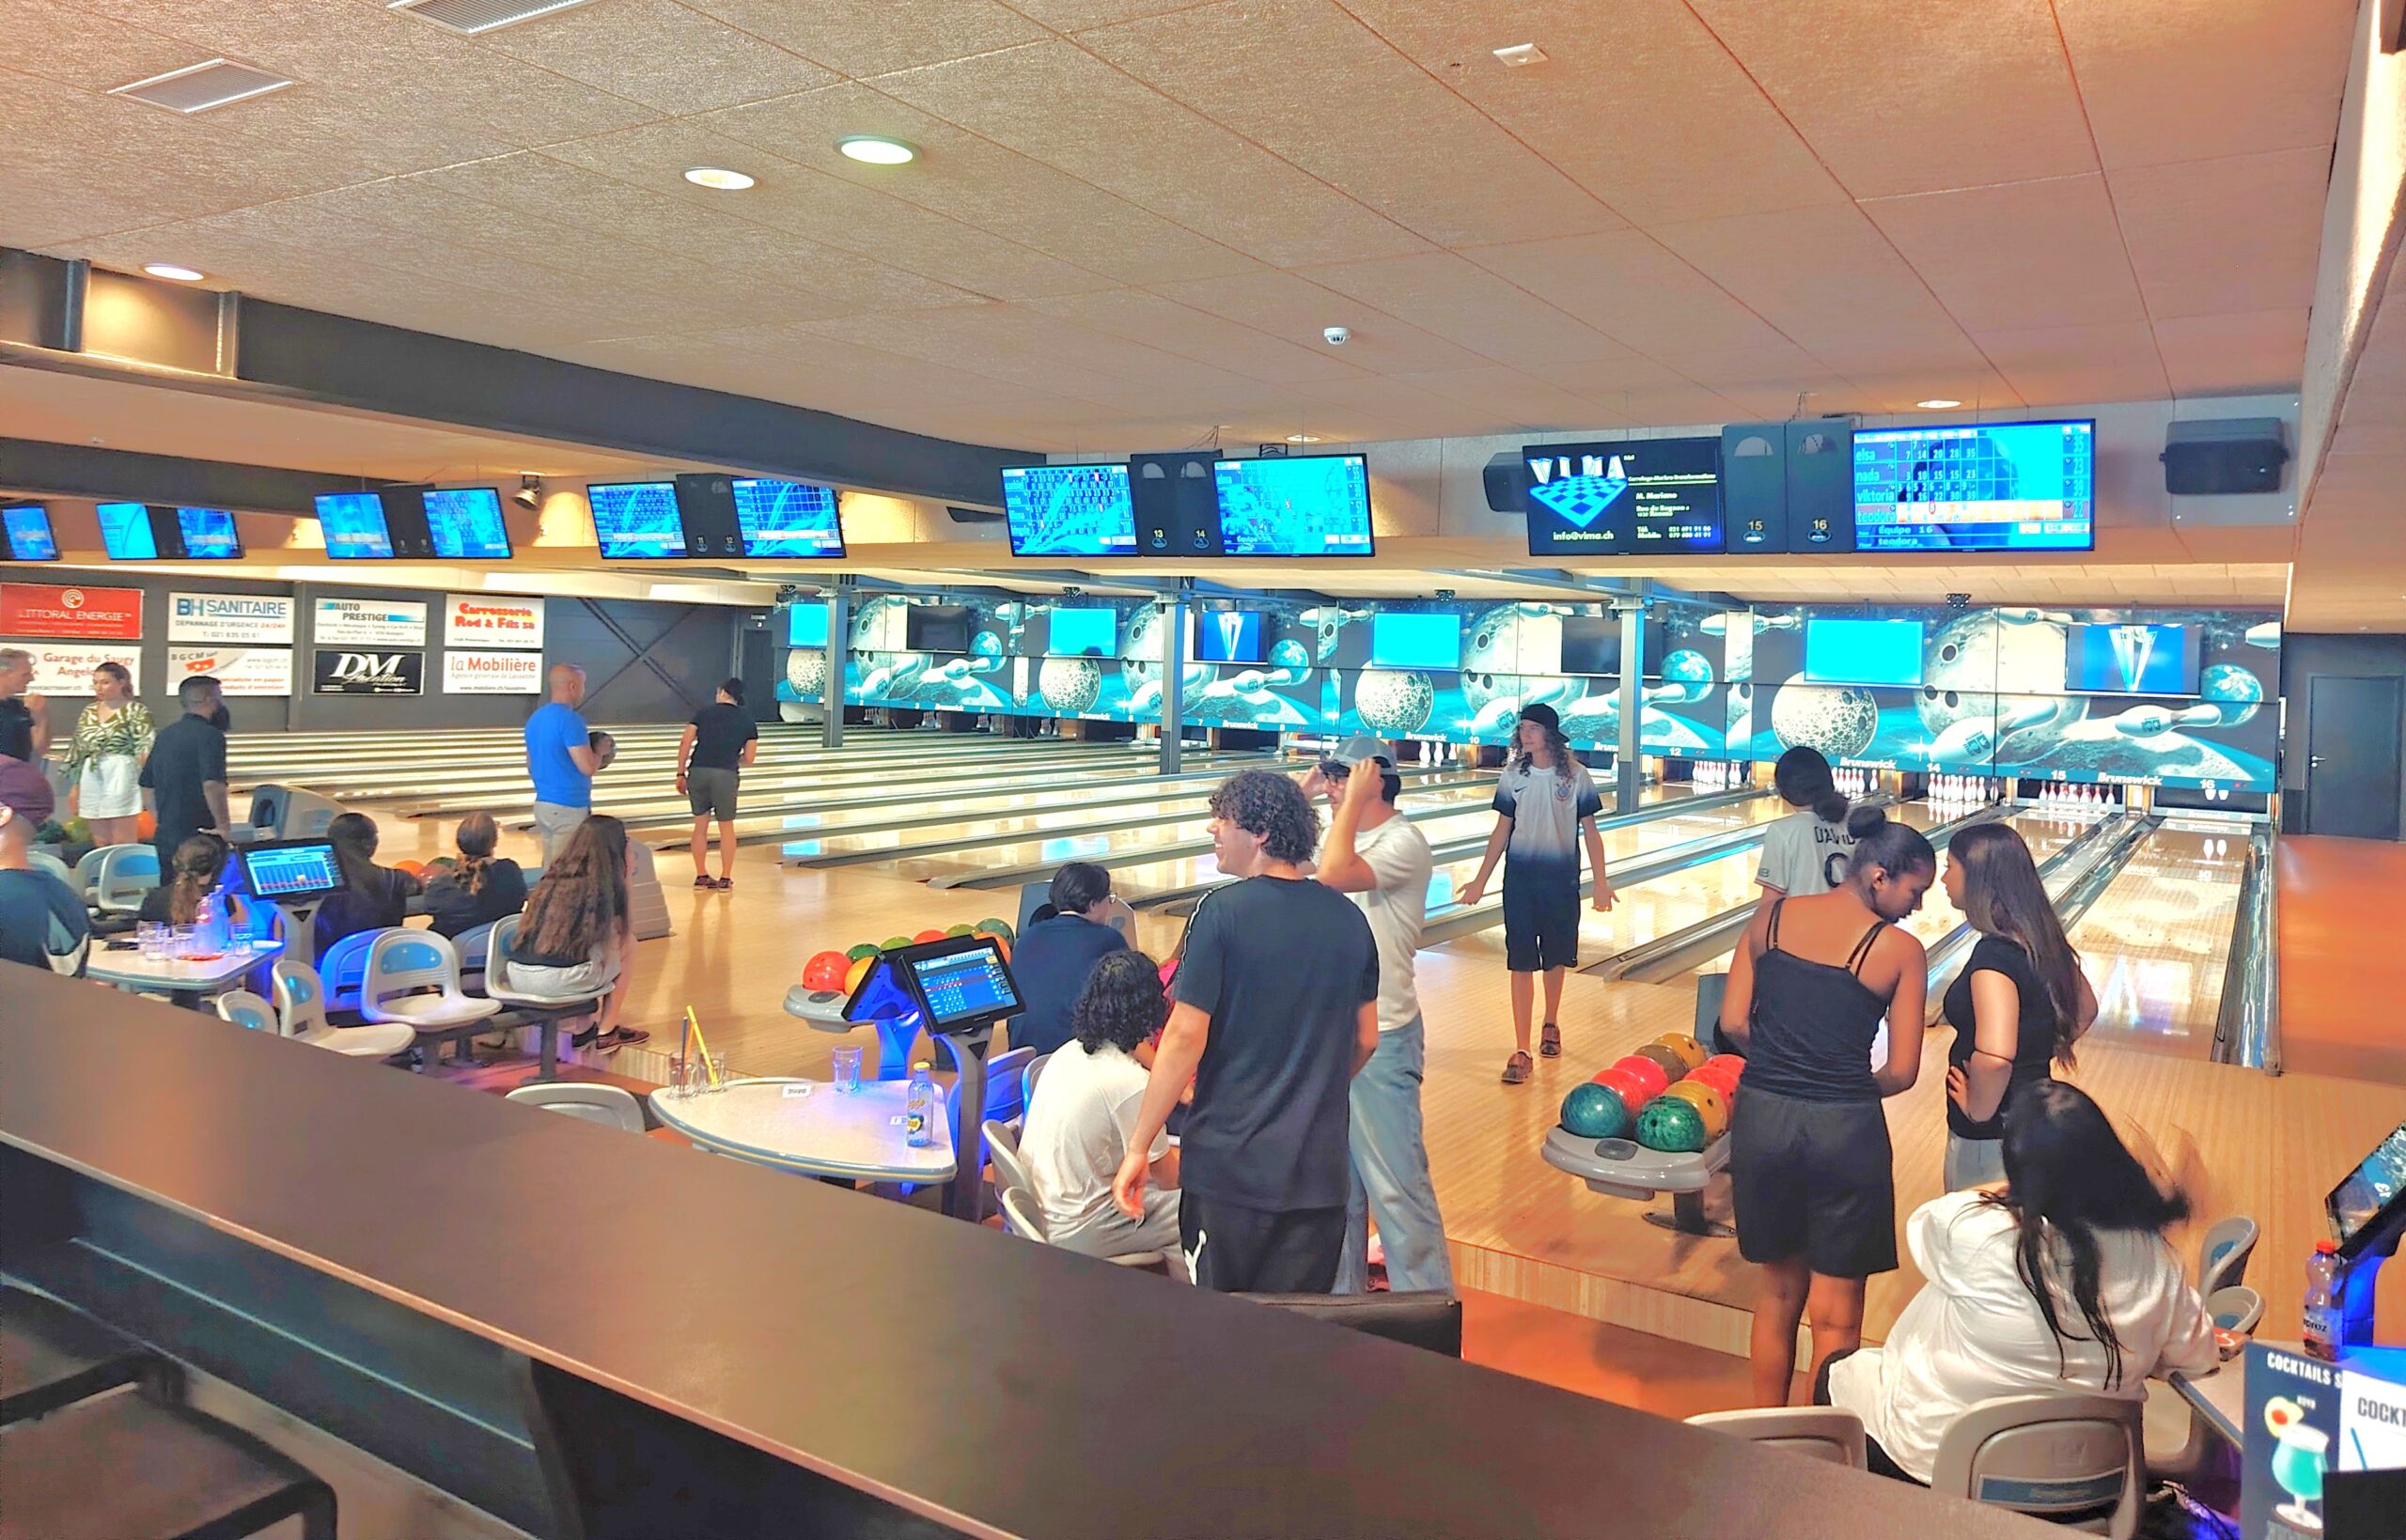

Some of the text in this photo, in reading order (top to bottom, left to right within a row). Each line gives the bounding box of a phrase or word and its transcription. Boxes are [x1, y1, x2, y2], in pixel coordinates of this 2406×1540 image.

[1855, 447, 1876, 460] elsa
[1917, 450, 1928, 459] 14
[1527, 454, 1626, 485] VIMA
[1855, 468, 1880, 482] nada
[1917, 471, 1928, 480] 10
[1857, 489, 1895, 502] viktoria
[1857, 510, 1896, 522] teodora
[1748, 521, 1763, 531] 15
[1813, 520, 1828, 530] 16
[1154, 529, 1164, 537] 13
[1553, 530, 1615, 540] info@vima.ch
[176, 599, 287, 616] BH SANITAIRE
[334, 602, 360, 611] AUTO
[459, 602, 533, 616] Carrosserie
[18, 609, 71, 619] LITTORAL
[76, 611, 123, 620] ENERGIE
[342, 612, 387, 622] PRESTIGE
[455, 615, 482, 628] Rod
[484, 619, 493, 628] &
[43, 652, 84, 665] Garage
[87, 654, 102, 663] du
[451, 656, 536, 672] la Mobilière
[329, 653, 406, 677] DM
[1197, 718, 1203, 726] 7
[1222, 719, 1259, 730] Brunswick
[1405, 731, 1446, 742] Brunswick
[1469, 736, 1480, 744] 10
[1669, 747, 1681, 756] 12
[1839, 756, 1898, 770] Brunswick
[1927, 762, 1941, 773] 14
[2051, 770, 2067, 781] 15
[2098, 771, 2164, 787] Brunswick
[2199, 779, 2215, 789] 16
[1814, 826, 1856, 845] DAVID
[2267, 1352, 2332, 1386] COCKTAILS
